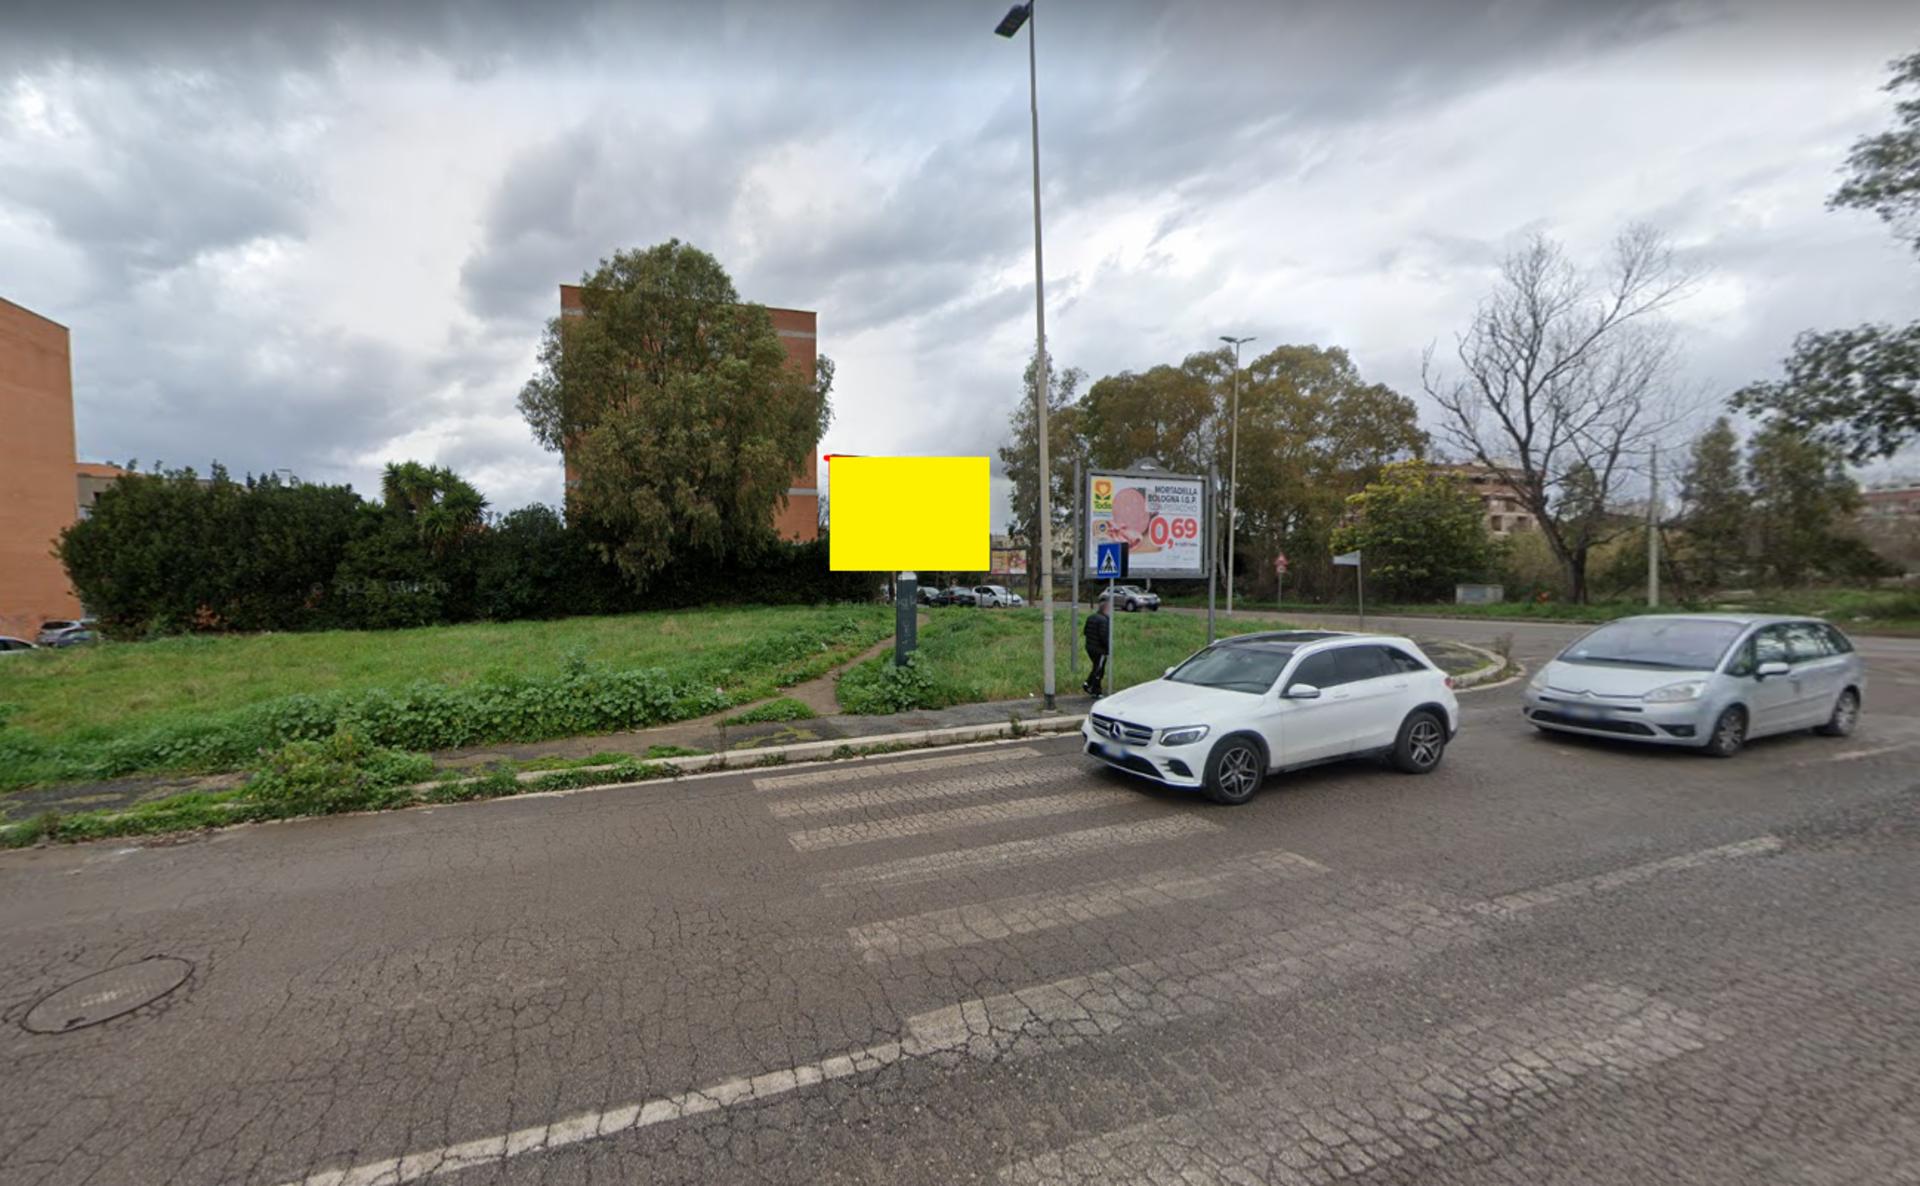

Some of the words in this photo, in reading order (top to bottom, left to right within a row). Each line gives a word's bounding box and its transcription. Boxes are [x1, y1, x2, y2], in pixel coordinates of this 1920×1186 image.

[1155, 485, 1197, 495] MORTADELLA
[1148, 494, 1179, 503] BOLOGNA
[1151, 516, 1198, 549] 0,69
